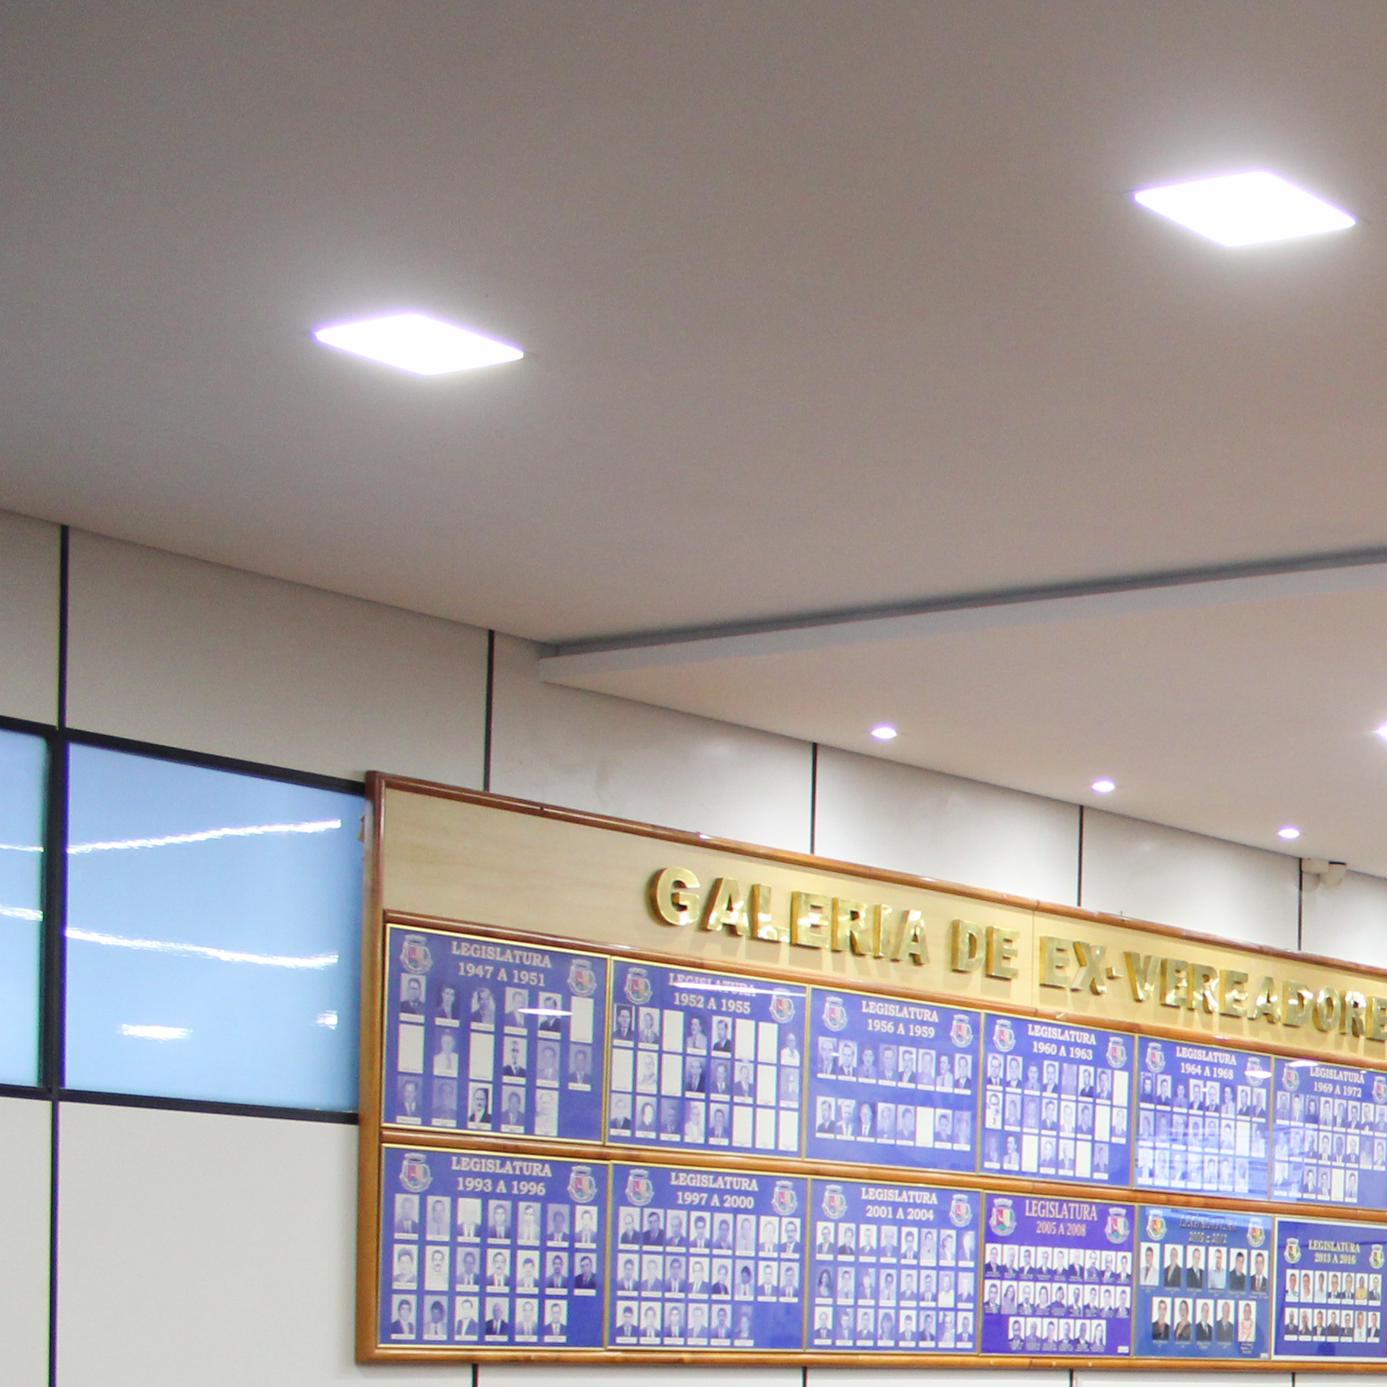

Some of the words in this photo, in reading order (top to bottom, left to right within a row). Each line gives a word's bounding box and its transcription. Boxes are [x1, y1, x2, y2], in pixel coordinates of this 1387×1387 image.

[651, 867, 929, 966] GALERIA
[952, 918, 1019, 979] DE
[451, 941, 552, 968] LEGISLATURA
[458, 962, 488, 978] 1947
[498, 967, 509, 981] A
[513, 970, 546, 987] 1951
[673, 992, 704, 1008] 1952
[707, 997, 717, 1010] A
[721, 999, 751, 1014] 1955
[861, 1000, 939, 1023] LEGISLATURA
[867, 1019, 894, 1034] 1956
[896, 1023, 906, 1036] A
[909, 1024, 935, 1039] 1959
[1028, 1023, 1096, 1046] LEGISLATURA
[1033, 1041, 1057, 1057] 1960
[1058, 1044, 1067, 1058] A
[1069, 1046, 1093, 1061] 1963
[1176, 1046, 1237, 1066] LEGISLATURA
[1181, 1062, 1201, 1075] 1964
[1204, 1066, 1211, 1077] A
[1310, 1066, 1365, 1084] LEGISLATURA
[1334, 1084, 1341, 1095] A
[1343, 1085, 1362, 1098] 1972
[451, 1156, 552, 1178] LEGISLATURA
[456, 1176, 492, 1192] 1993
[496, 1179, 507, 1193] A
[511, 1180, 546, 1196] 1996
[670, 1171, 759, 1192] LEGISLATURA
[676, 1190, 707, 1206] 1997
[710, 1193, 721, 1207] A
[722, 1194, 755, 1209] 2000
[861, 1186, 939, 1205] LEGISLATURA
[865, 1205, 894, 1219] 2001
[895, 1207, 905, 1220] A
[906, 1208, 935, 1221] 2004
[1024, 1199, 1098, 1221] LEGISLATURA
[1058, 1223, 1065, 1235] A
[1066, 1222, 1087, 1237] 2008
[1308, 1239, 1360, 1253] LEGISLATURA
